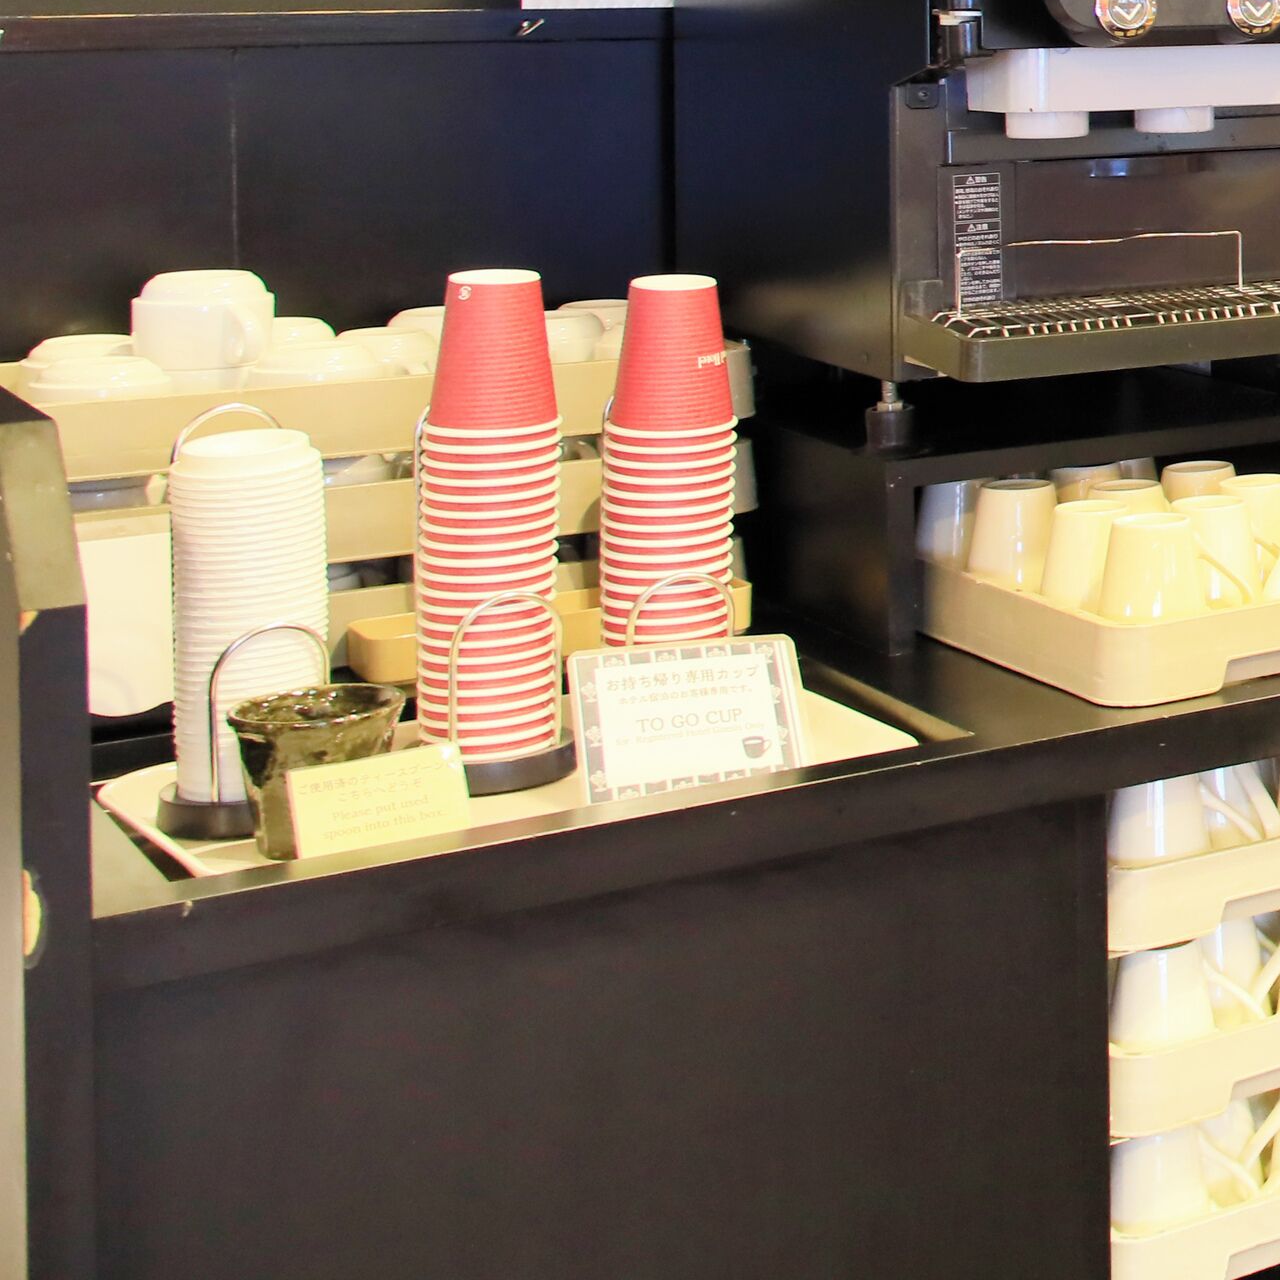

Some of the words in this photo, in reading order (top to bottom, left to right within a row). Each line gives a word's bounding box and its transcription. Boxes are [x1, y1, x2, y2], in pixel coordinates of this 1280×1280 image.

[607, 664, 760, 692] お持ち帰り専用カップ
[636, 717, 665, 733] TO
[671, 713, 700, 729] GO
[705, 708, 743, 726] CUP
[333, 806, 373, 822] Please
[375, 802, 397, 818] put
[400, 794, 430, 811] used
[324, 824, 362, 841] spoon
[365, 818, 390, 832] into
[393, 812, 416, 826] this
